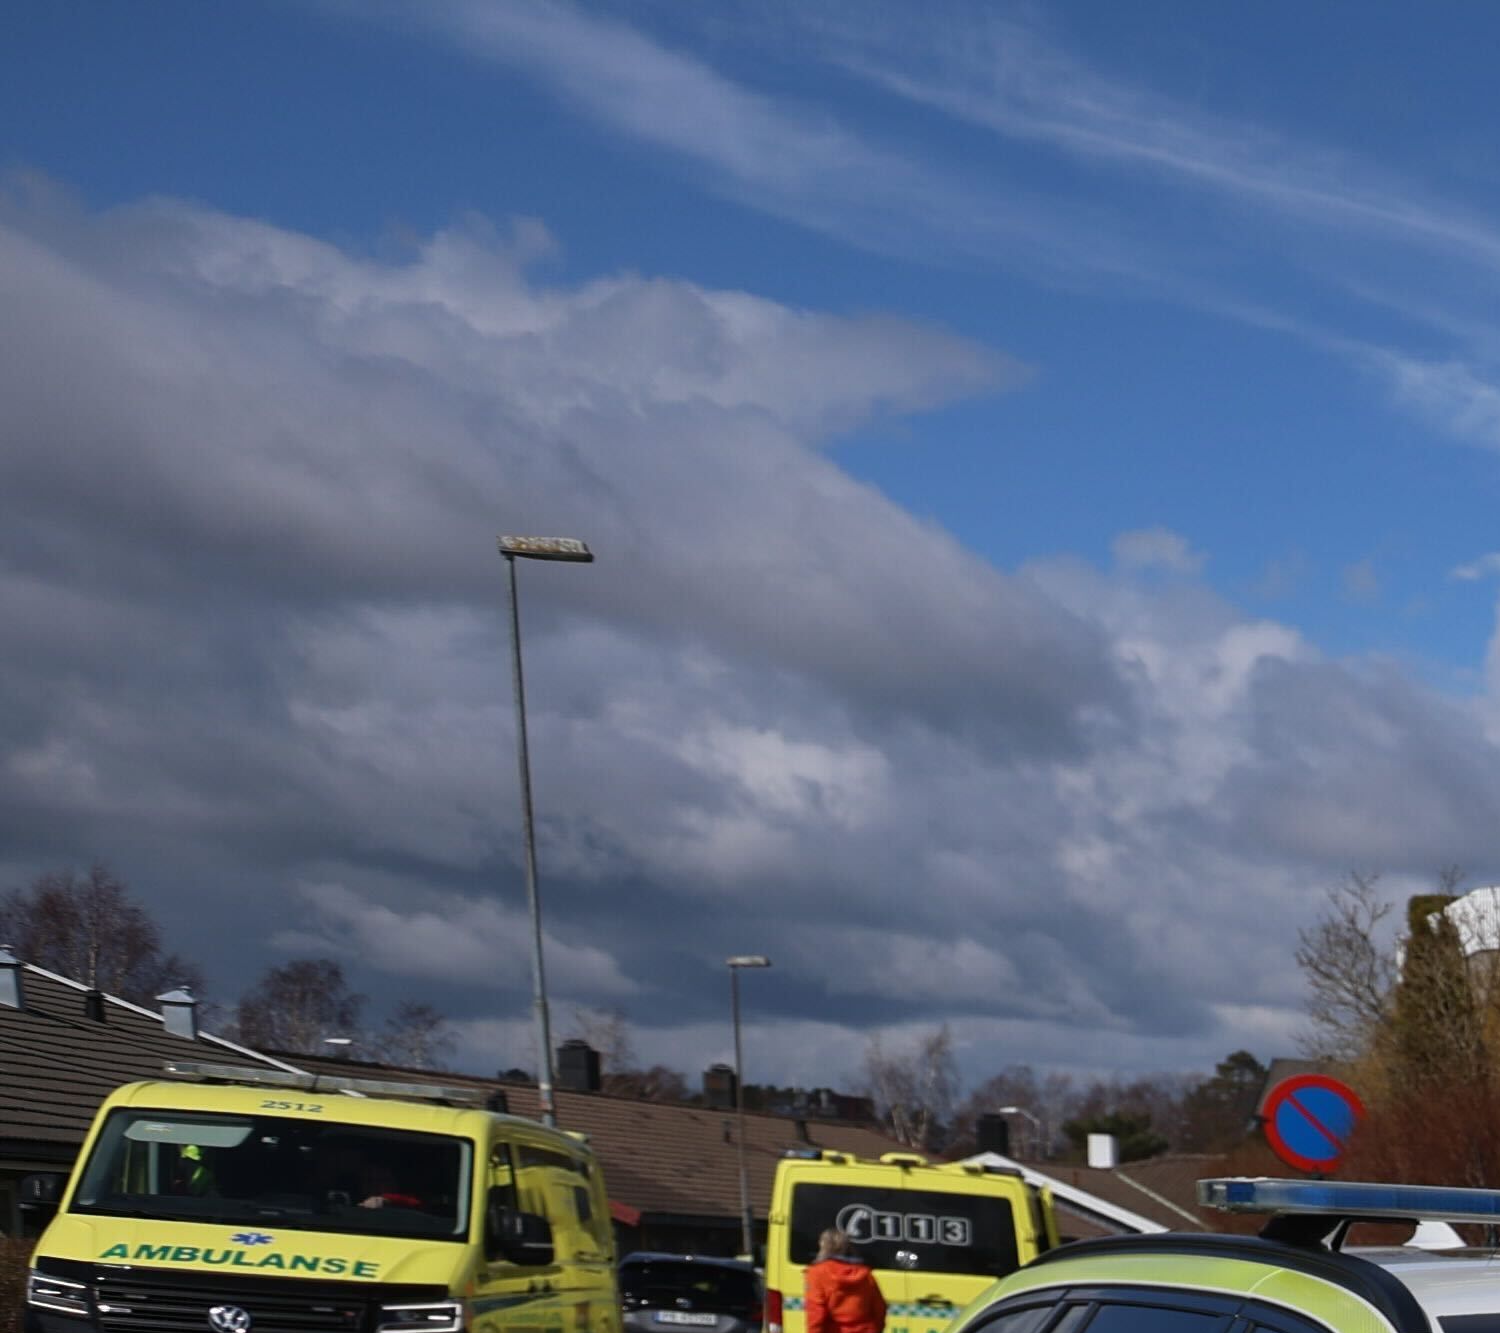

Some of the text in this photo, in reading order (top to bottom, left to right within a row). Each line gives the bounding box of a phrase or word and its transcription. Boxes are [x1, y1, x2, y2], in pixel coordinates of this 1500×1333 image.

[260, 1100, 323, 1113] 2512
[879, 1216, 964, 1243] 113
[98, 1243, 381, 1278] AMBULANSE
